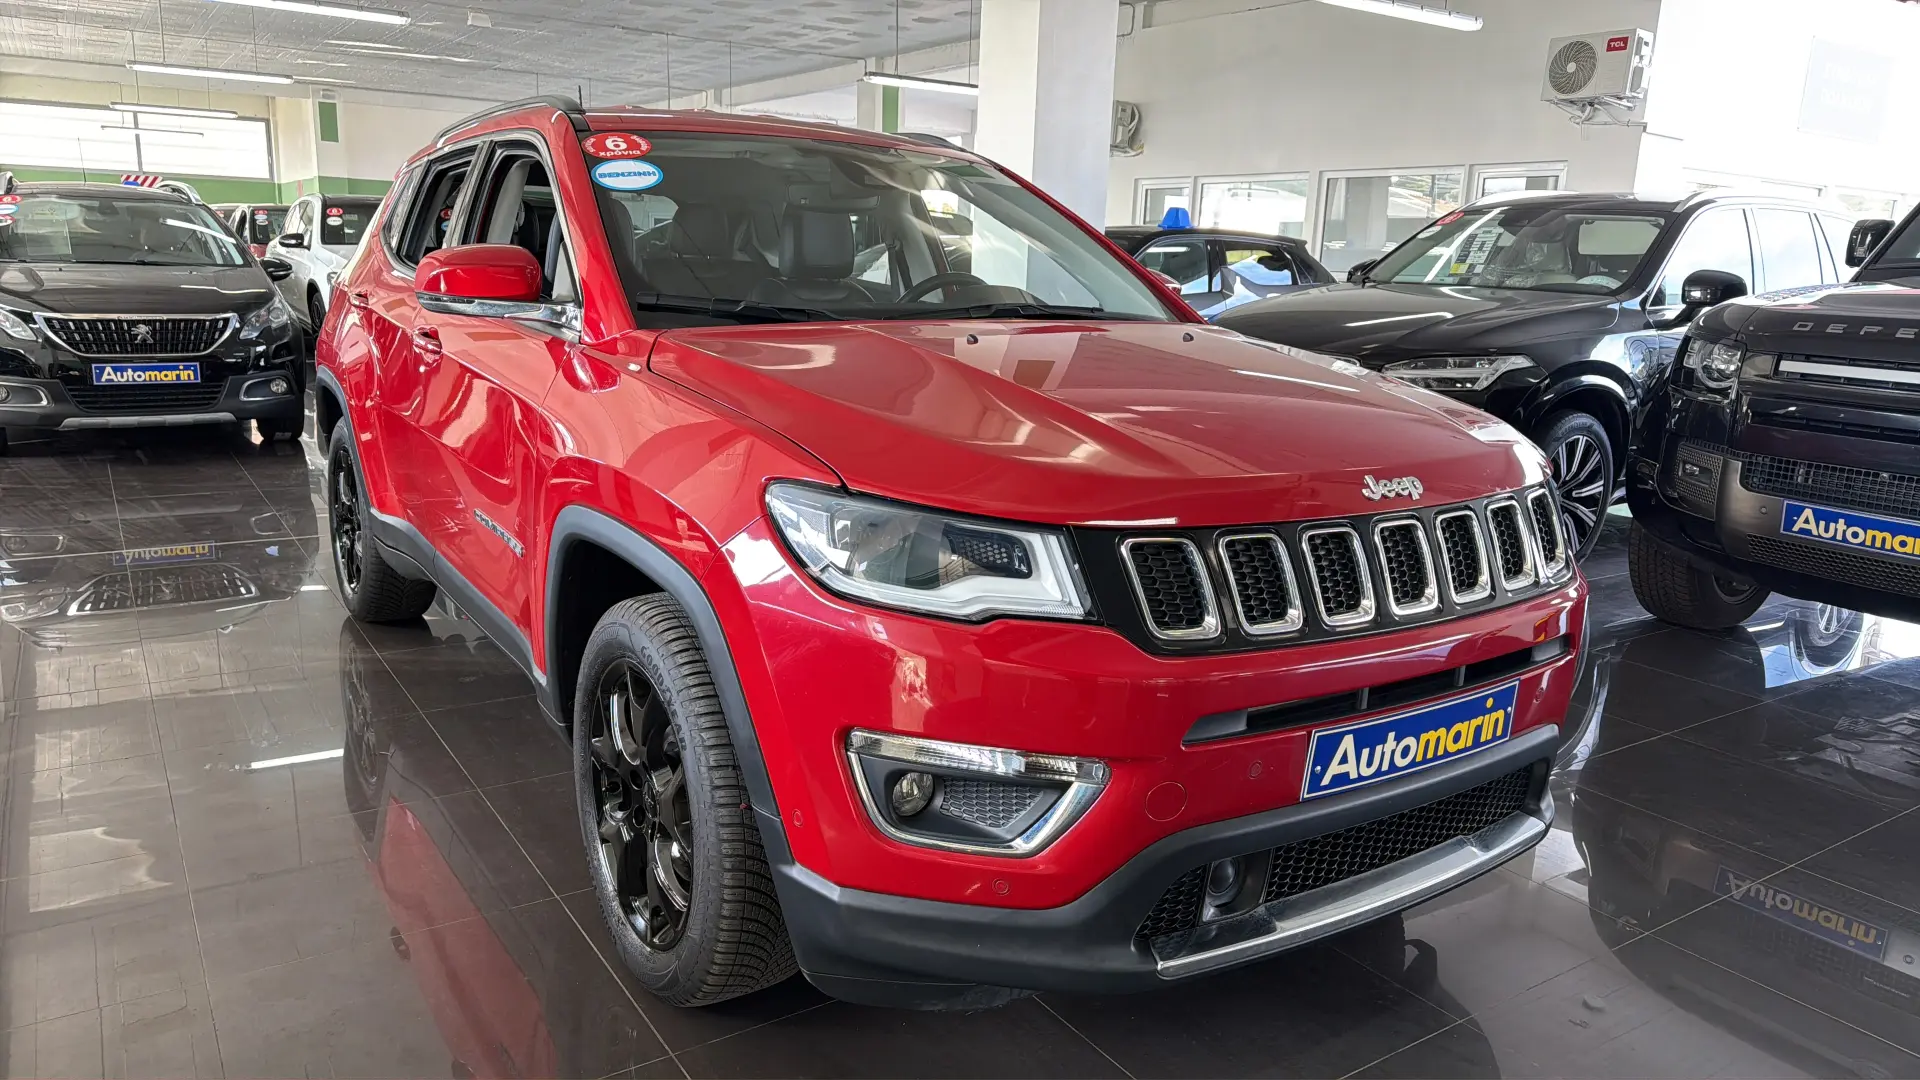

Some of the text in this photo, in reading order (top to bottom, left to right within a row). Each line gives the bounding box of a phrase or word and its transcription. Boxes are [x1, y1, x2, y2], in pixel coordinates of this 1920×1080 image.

[605, 137, 628, 151] 6
[1792, 321, 1920, 339] DEFE
[101, 365, 195, 382] Automarin
[1361, 474, 1423, 501] Jeep
[1320, 697, 1505, 787] Automarin
